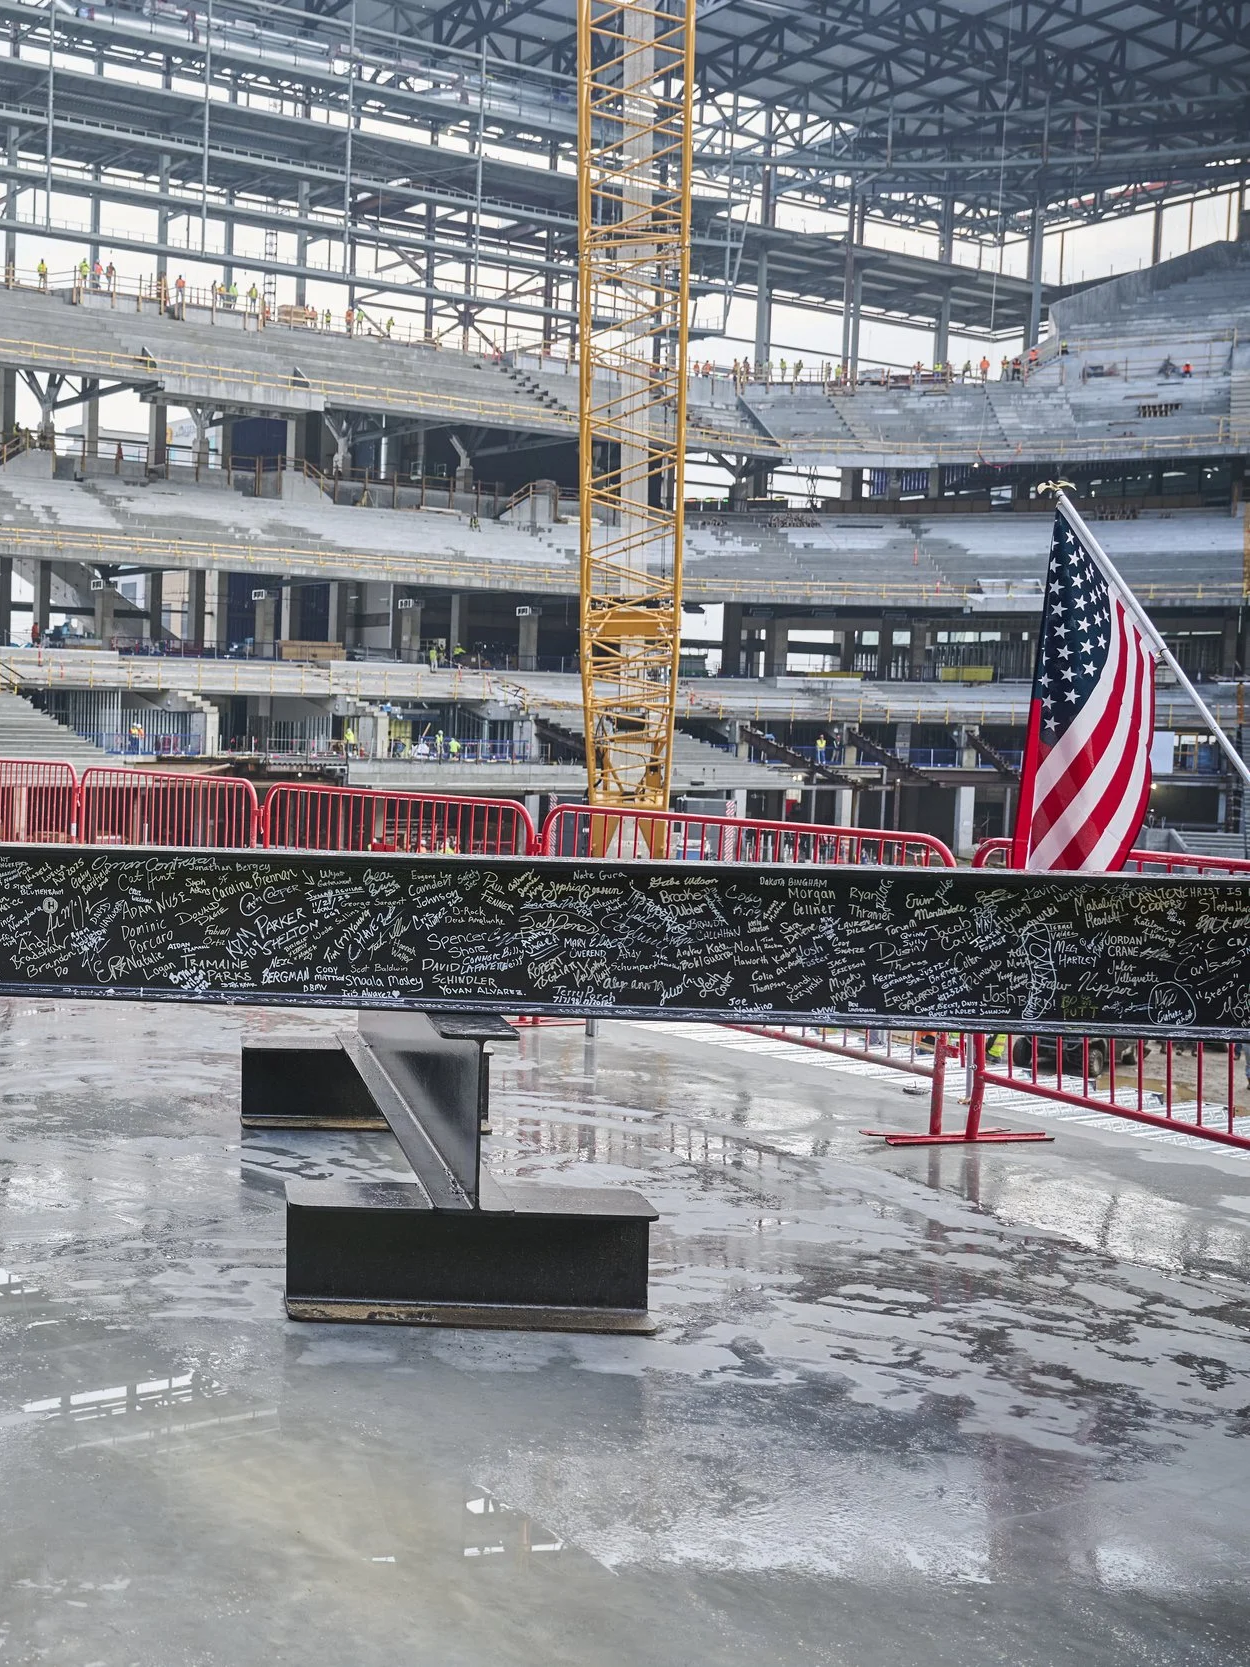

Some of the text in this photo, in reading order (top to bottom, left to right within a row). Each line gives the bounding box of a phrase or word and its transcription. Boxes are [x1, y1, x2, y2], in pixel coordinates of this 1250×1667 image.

[190, 860, 233, 873] Jonathan
[573, 870, 595, 880] Nate
[787, 877, 827, 887] BINGHAM
[211, 868, 297, 901] Caroline Brennan
[788, 887, 836, 906] Morgan
[793, 901, 835, 916] Gellner
[121, 921, 167, 941] Dominic
[253, 907, 308, 940] PARKER
[129, 930, 173, 956] Porcaro
[733, 938, 763, 954] Noah
[1104, 935, 1143, 946] JORDAN
[1107, 947, 1139, 957] CRANE
[26, 950, 76, 978] Brandon
[126, 952, 165, 972] Natalie
[180, 953, 250, 971] TRAMAINE
[374, 962, 409, 973] Baldwin
[207, 970, 252, 983] PARKS
[261, 966, 310, 986] BERGMAN
[751, 970, 774, 982] Colin
